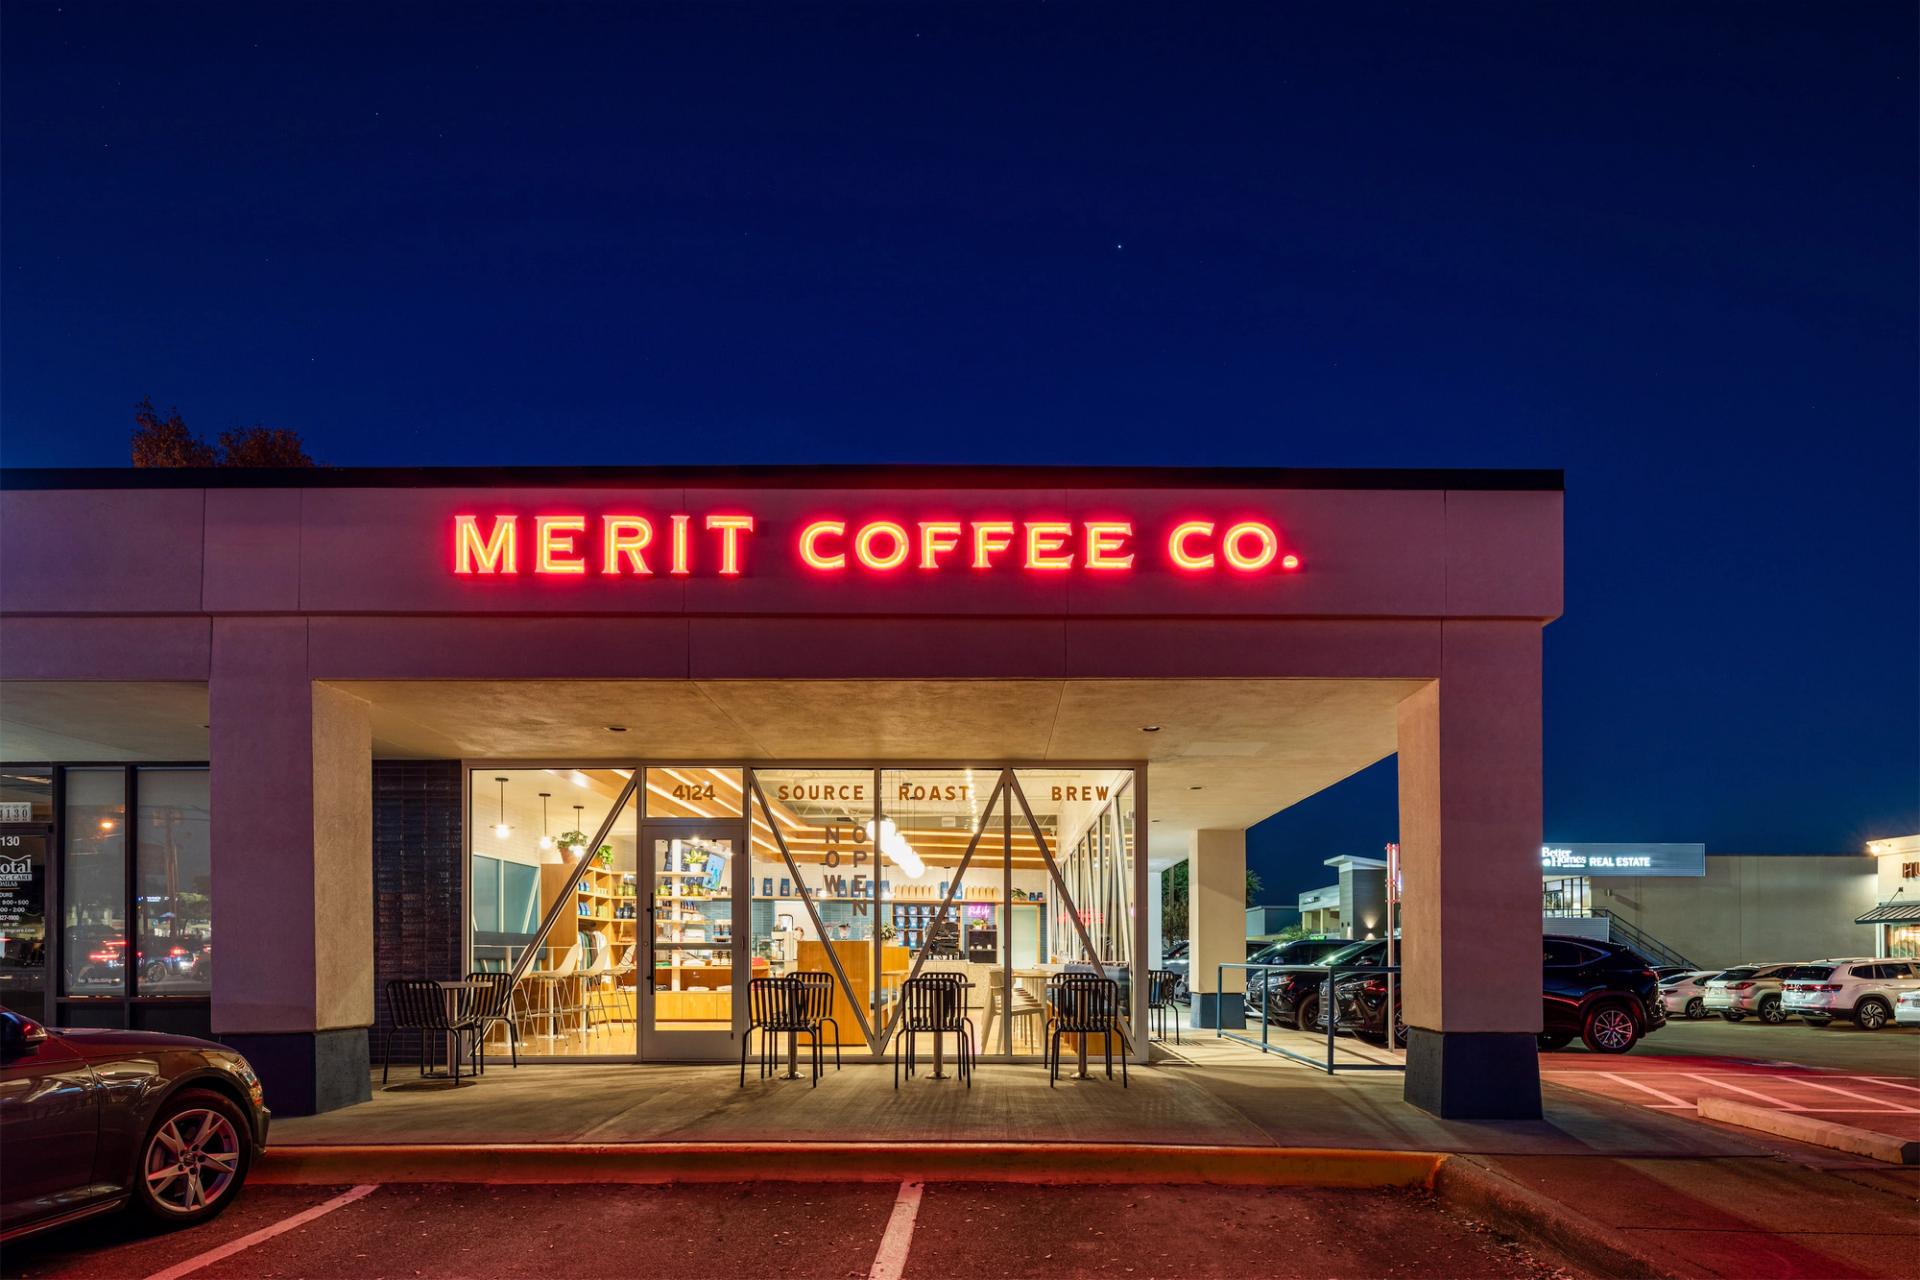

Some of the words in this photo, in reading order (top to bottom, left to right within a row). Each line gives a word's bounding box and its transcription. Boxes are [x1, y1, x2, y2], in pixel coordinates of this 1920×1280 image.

[454, 514, 753, 574] MERIT
[799, 520, 1135, 570] COFFEE
[1168, 520, 1298, 570] CO.
[672, 784, 716, 800] 4124
[778, 785, 864, 801] SOURCE
[899, 785, 970, 801] ROAST
[1051, 786, 1109, 801] BREW
[1541, 846, 1572, 858] Better
[1551, 855, 1586, 867] Homes
[1589, 857, 1615, 867] REAL
[1615, 857, 1651, 867] ESTATE
